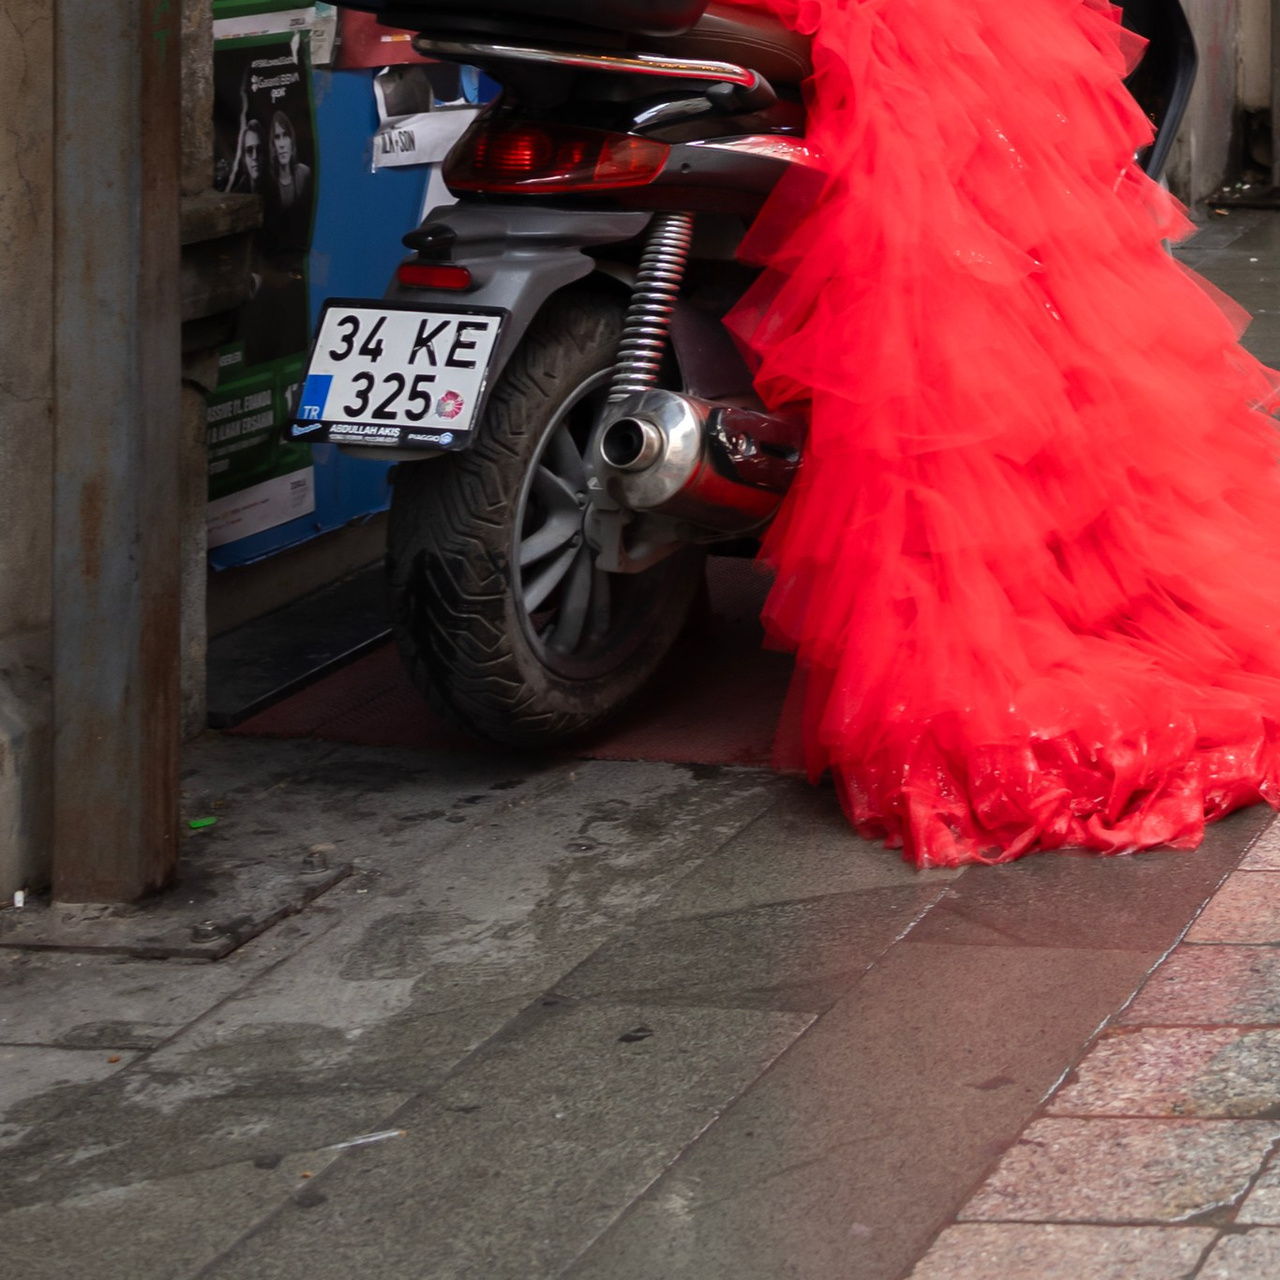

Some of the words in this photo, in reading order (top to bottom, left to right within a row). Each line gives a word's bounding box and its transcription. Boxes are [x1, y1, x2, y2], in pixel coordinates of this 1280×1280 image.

[328, 314, 388, 363] 34
[407, 318, 489, 370] KE
[302, 405, 321, 420] TR
[342, 370, 437, 422] 325
[329, 423, 378, 435] ABDULLAH
